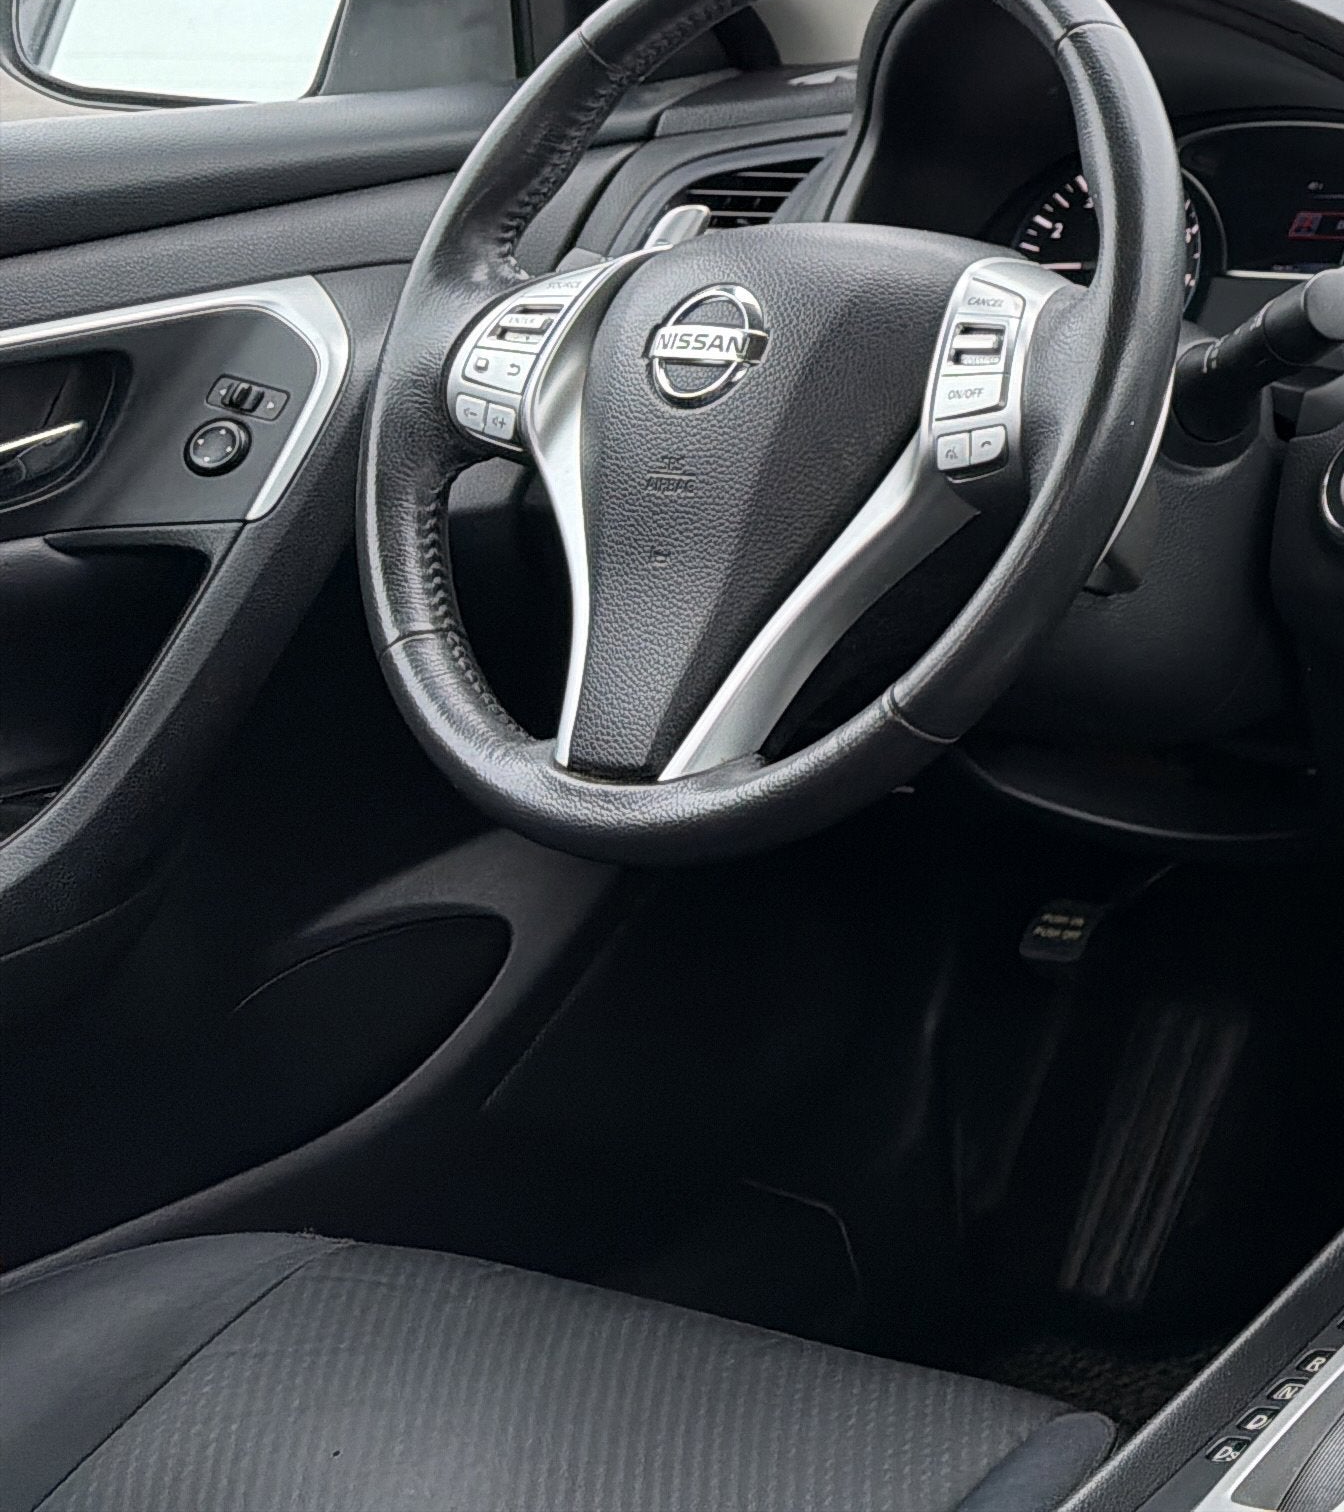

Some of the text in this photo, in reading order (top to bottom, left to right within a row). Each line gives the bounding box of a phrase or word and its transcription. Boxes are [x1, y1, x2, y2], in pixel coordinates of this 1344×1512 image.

[1050, 223, 1064, 239] 2
[657, 327, 748, 355] NISSAN
[947, 387, 985, 400] ON/OFF
[1307, 1356, 1327, 1373] R
[1275, 1386, 1299, 1400] N
[1249, 1415, 1270, 1430] D
